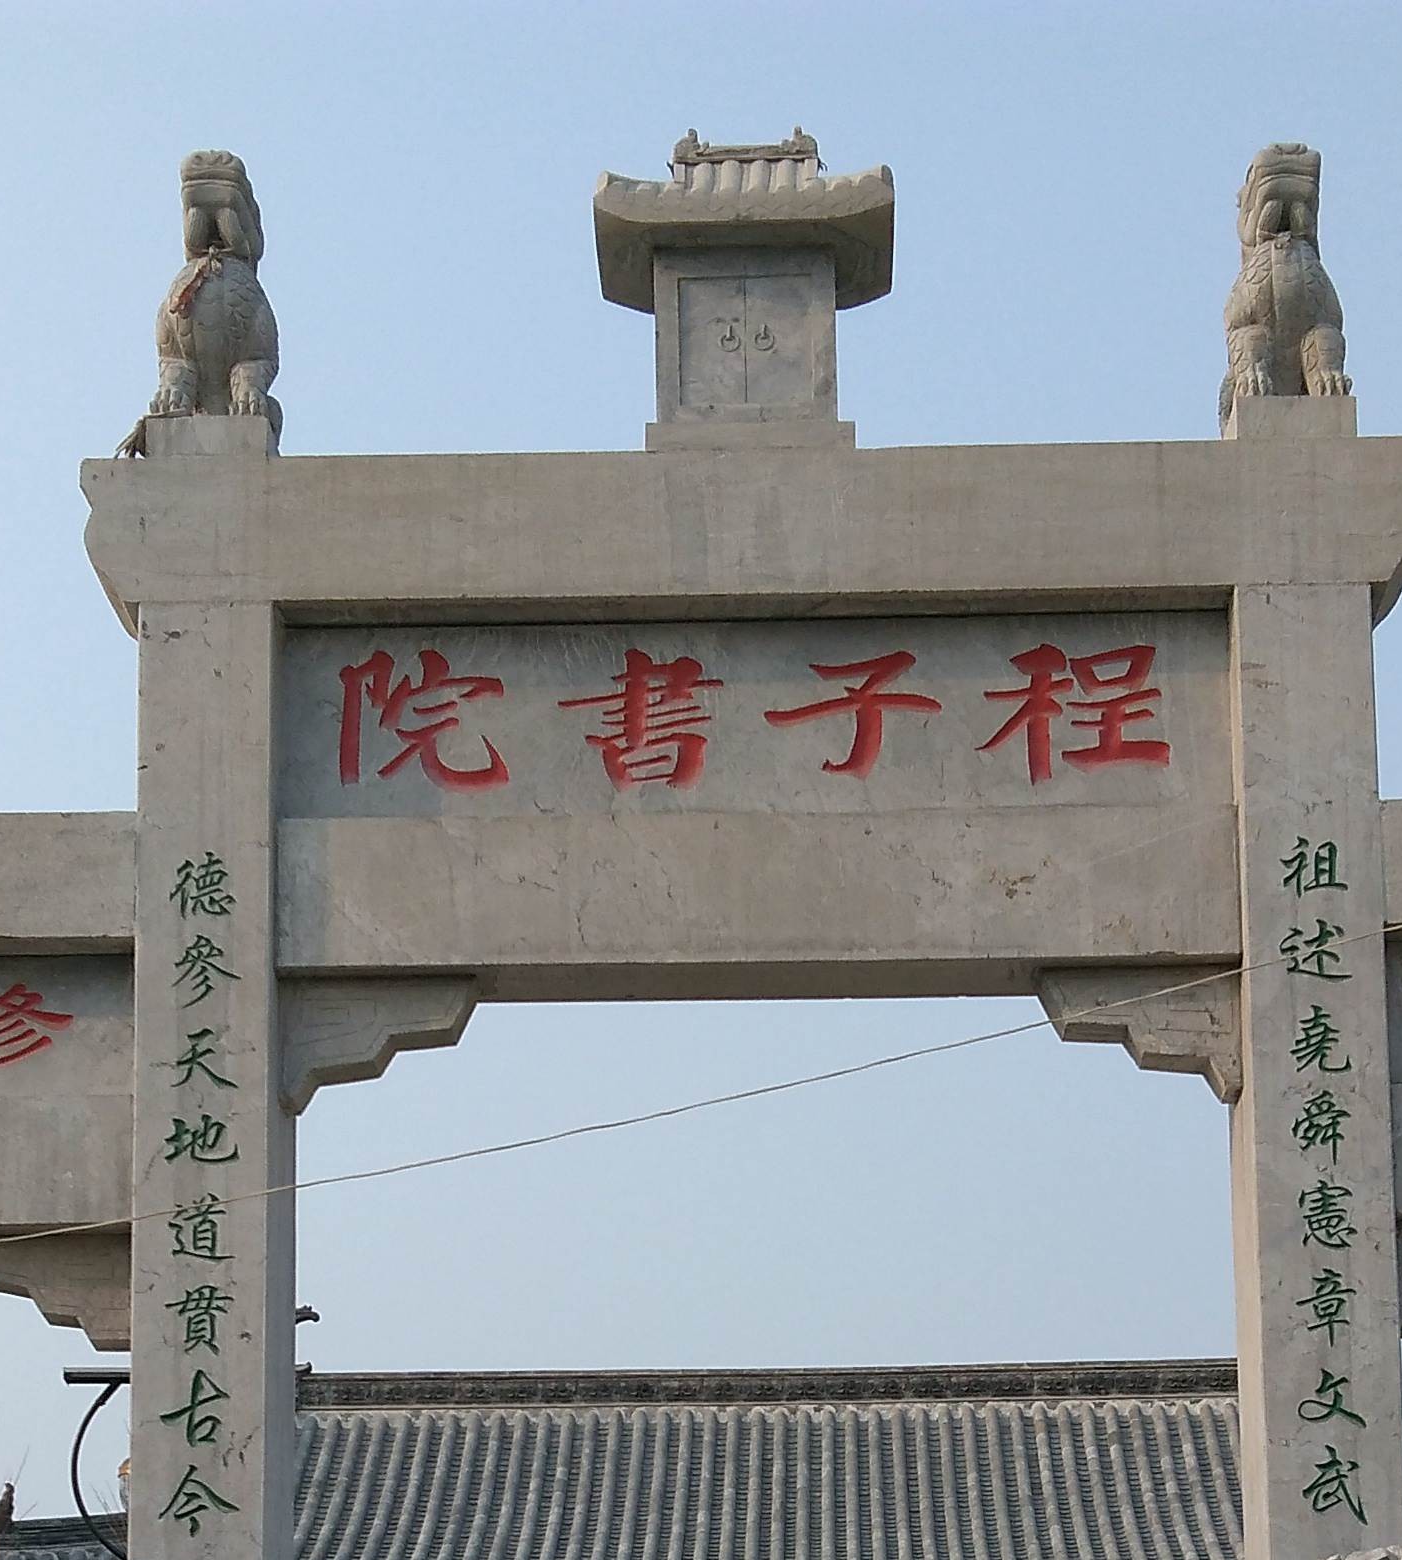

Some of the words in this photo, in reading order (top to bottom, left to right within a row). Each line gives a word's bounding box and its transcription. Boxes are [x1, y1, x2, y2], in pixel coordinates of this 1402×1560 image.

[337, 642, 1171, 792] 程子書院
[159, 850, 242, 1538] 德參天地道貫古今
[1279, 834, 1368, 1527] 祖述堯舜憲章文武
